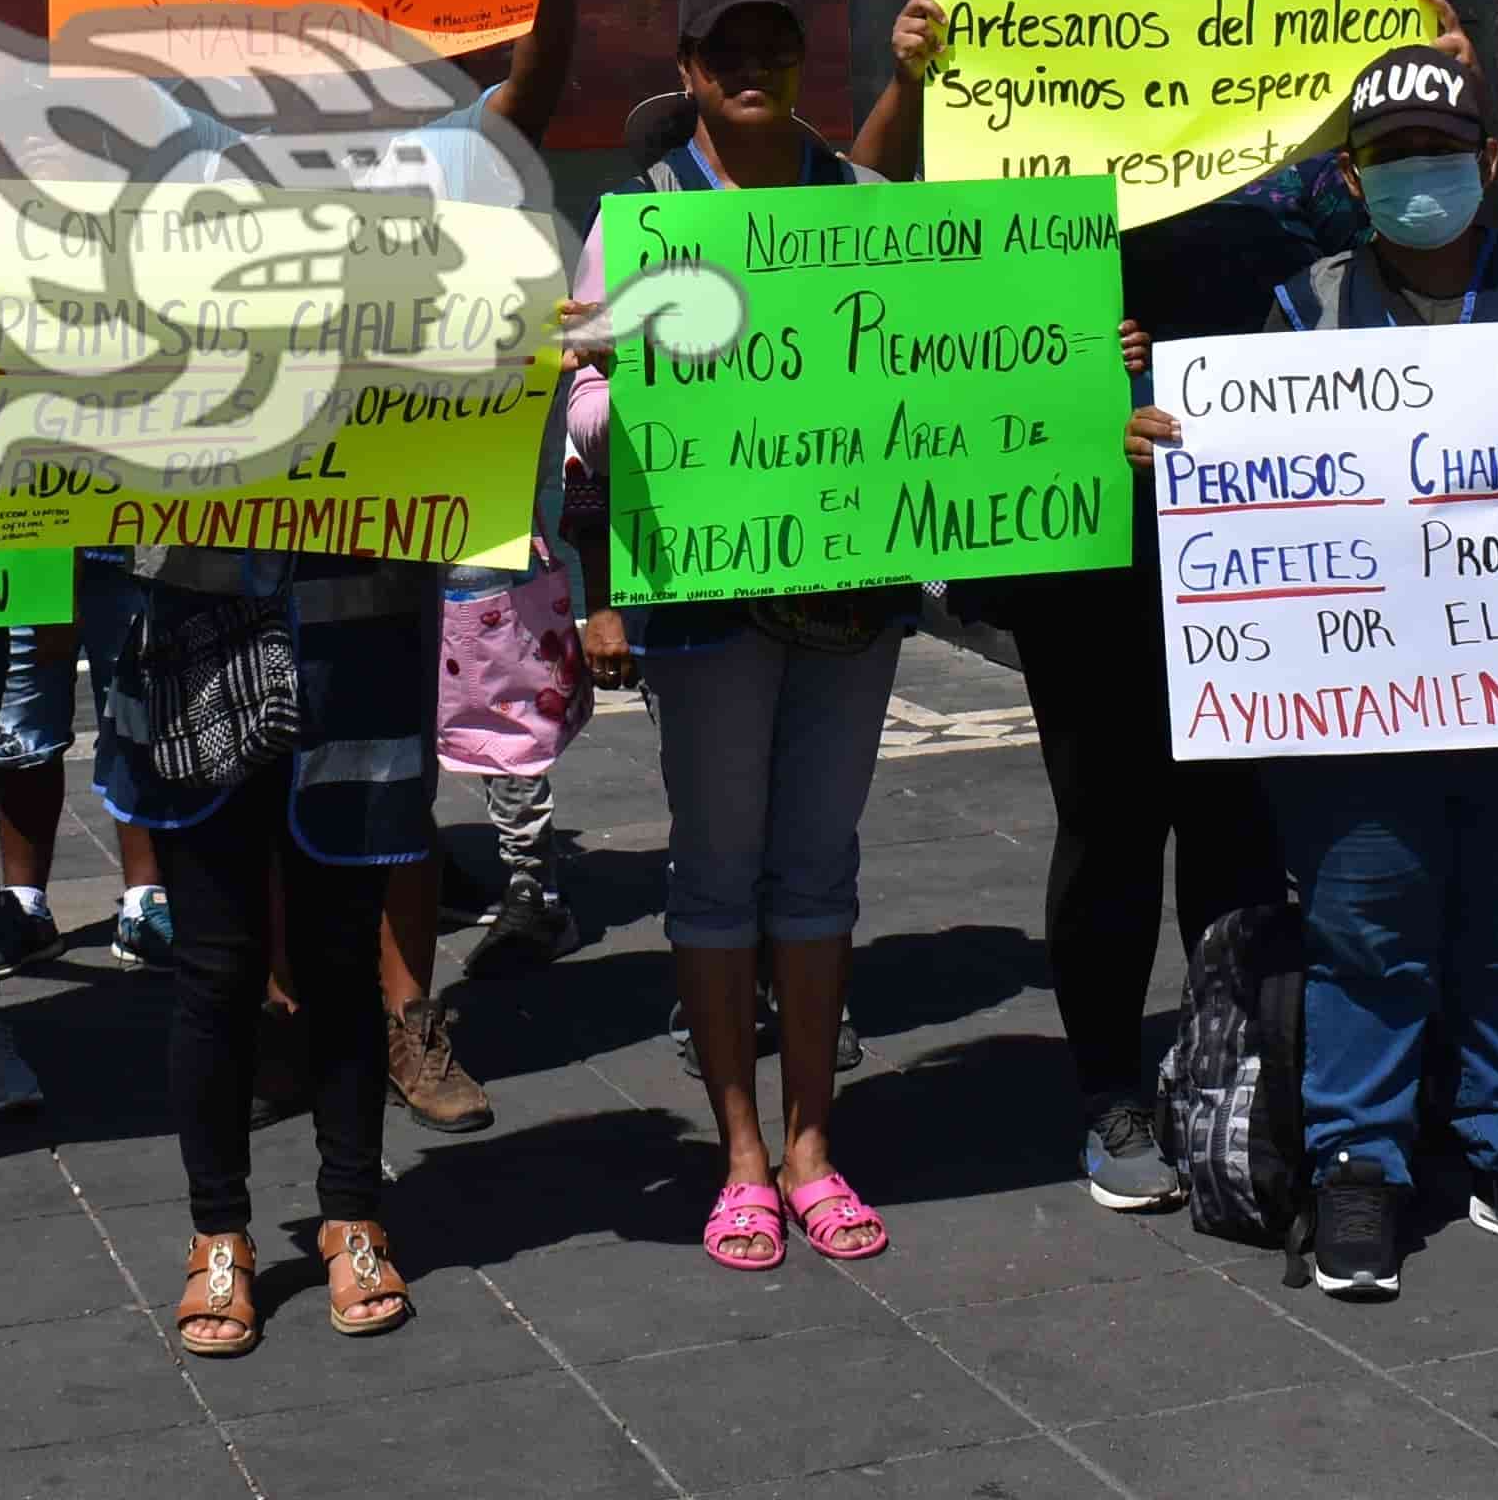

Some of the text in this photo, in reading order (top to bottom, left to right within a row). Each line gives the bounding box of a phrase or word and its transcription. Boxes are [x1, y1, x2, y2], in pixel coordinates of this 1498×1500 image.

[1145, 80, 1188, 108] en
[1211, 71, 1331, 113] espera
[1352, 62, 1465, 113] #LUCY
[348, 212, 443, 257] CON
[638, 205, 1119, 276] SIN NOTIFICACIÓN ALGUNA
[285, 290, 527, 357] CHALECOS
[1182, 356, 1434, 417] CONTAMOS
[163, 448, 242, 488] POR
[289, 441, 346, 480] EL
[628, 421, 706, 475] DE
[730, 417, 865, 470] NUESTRA
[993, 414, 1049, 454] DE
[820, 486, 860, 514] EN
[1165, 451, 1365, 506] PERMISOS
[108, 495, 469, 564] AYUNTAMIENTO
[622, 472, 1101, 577] TRABAJO EL MALECÓN
[1177, 531, 1379, 592] GAFETES
[1182, 622, 1271, 665] DOS
[1317, 608, 1396, 654] POR
